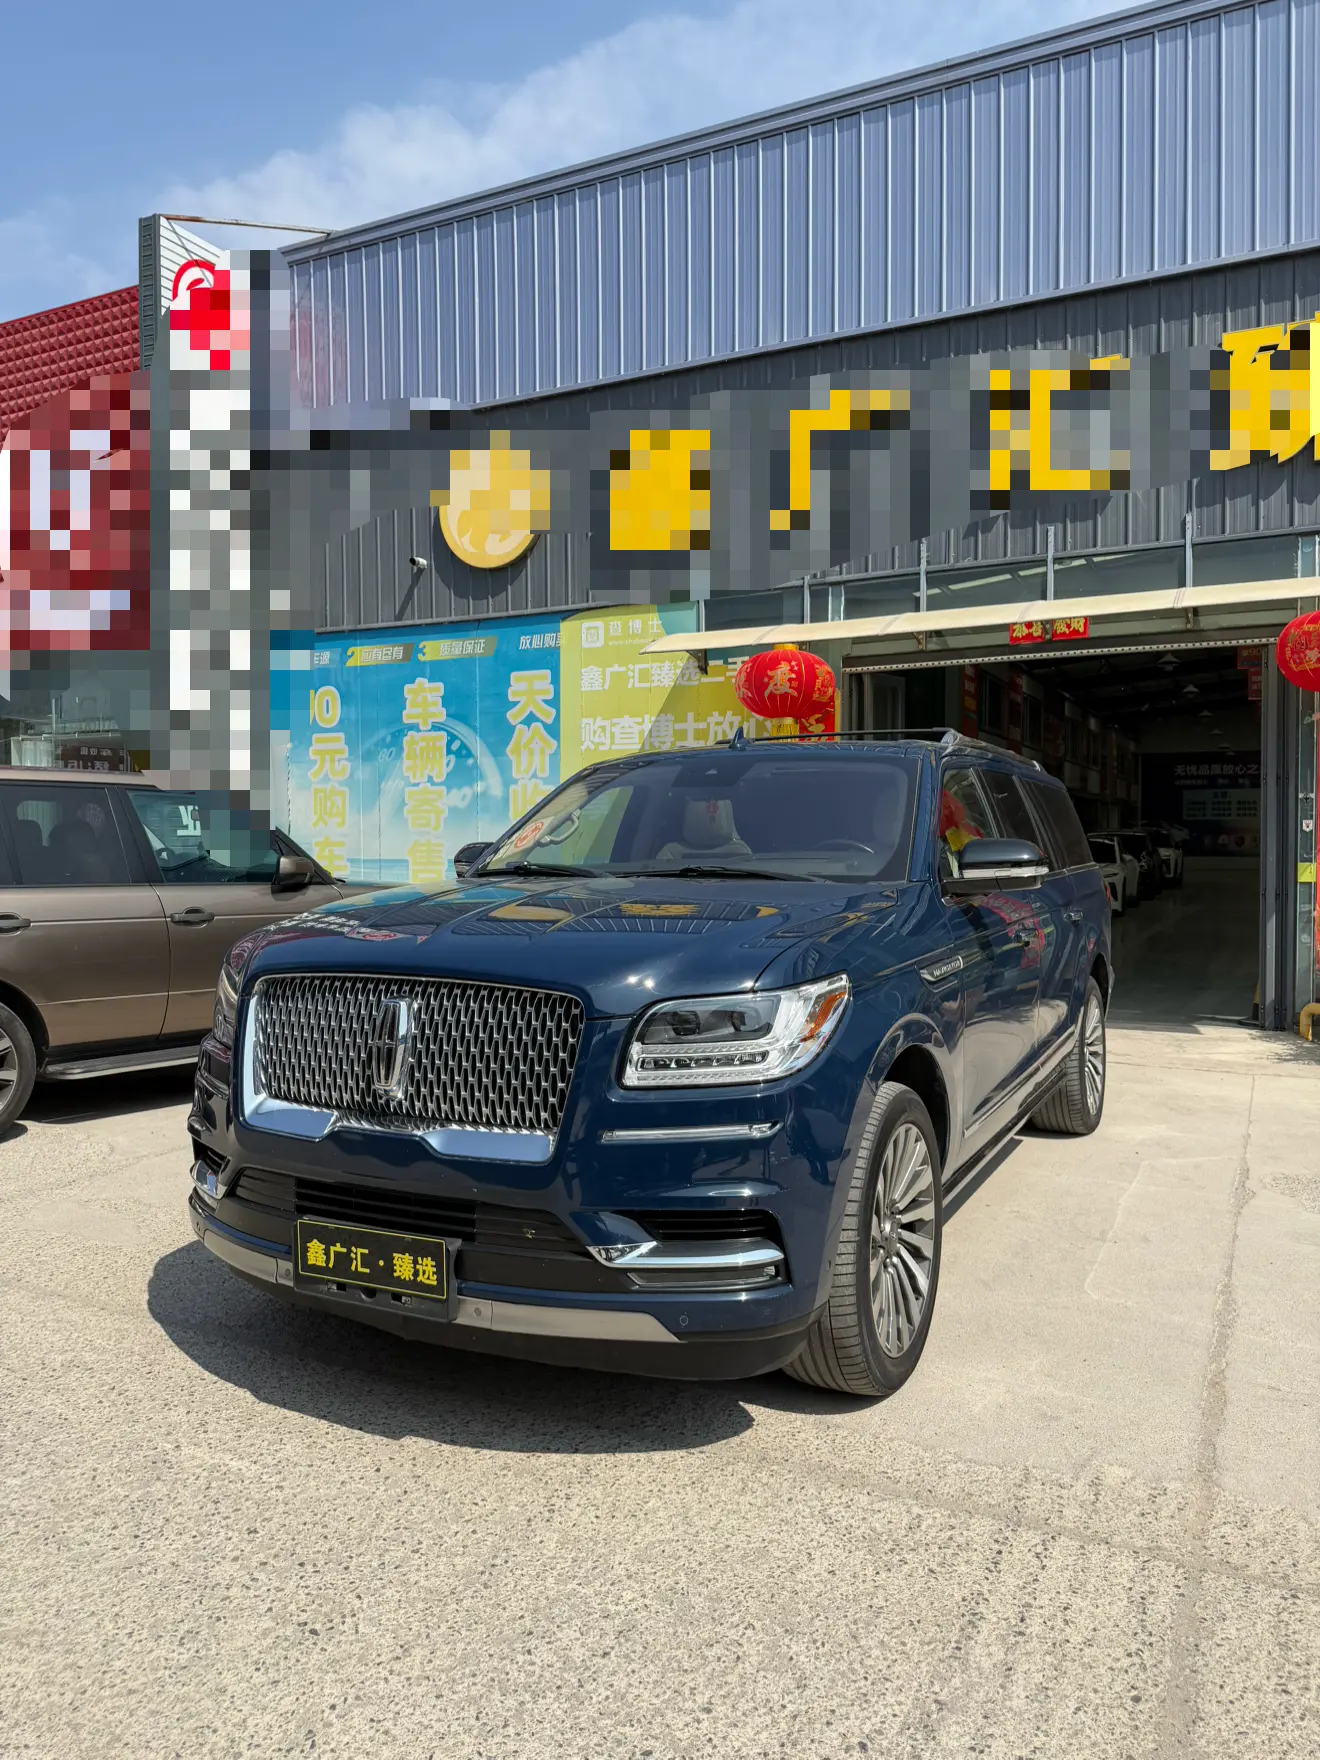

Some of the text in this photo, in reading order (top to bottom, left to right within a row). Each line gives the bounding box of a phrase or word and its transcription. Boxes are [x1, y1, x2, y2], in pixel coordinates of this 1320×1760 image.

[361, 646, 404, 663] 应有尽有
[439, 639, 486, 657] 质量保证
[402, 677, 447, 882] 车辆寄售
[306, 1238, 438, 1286] 鑫广汇·臻选
